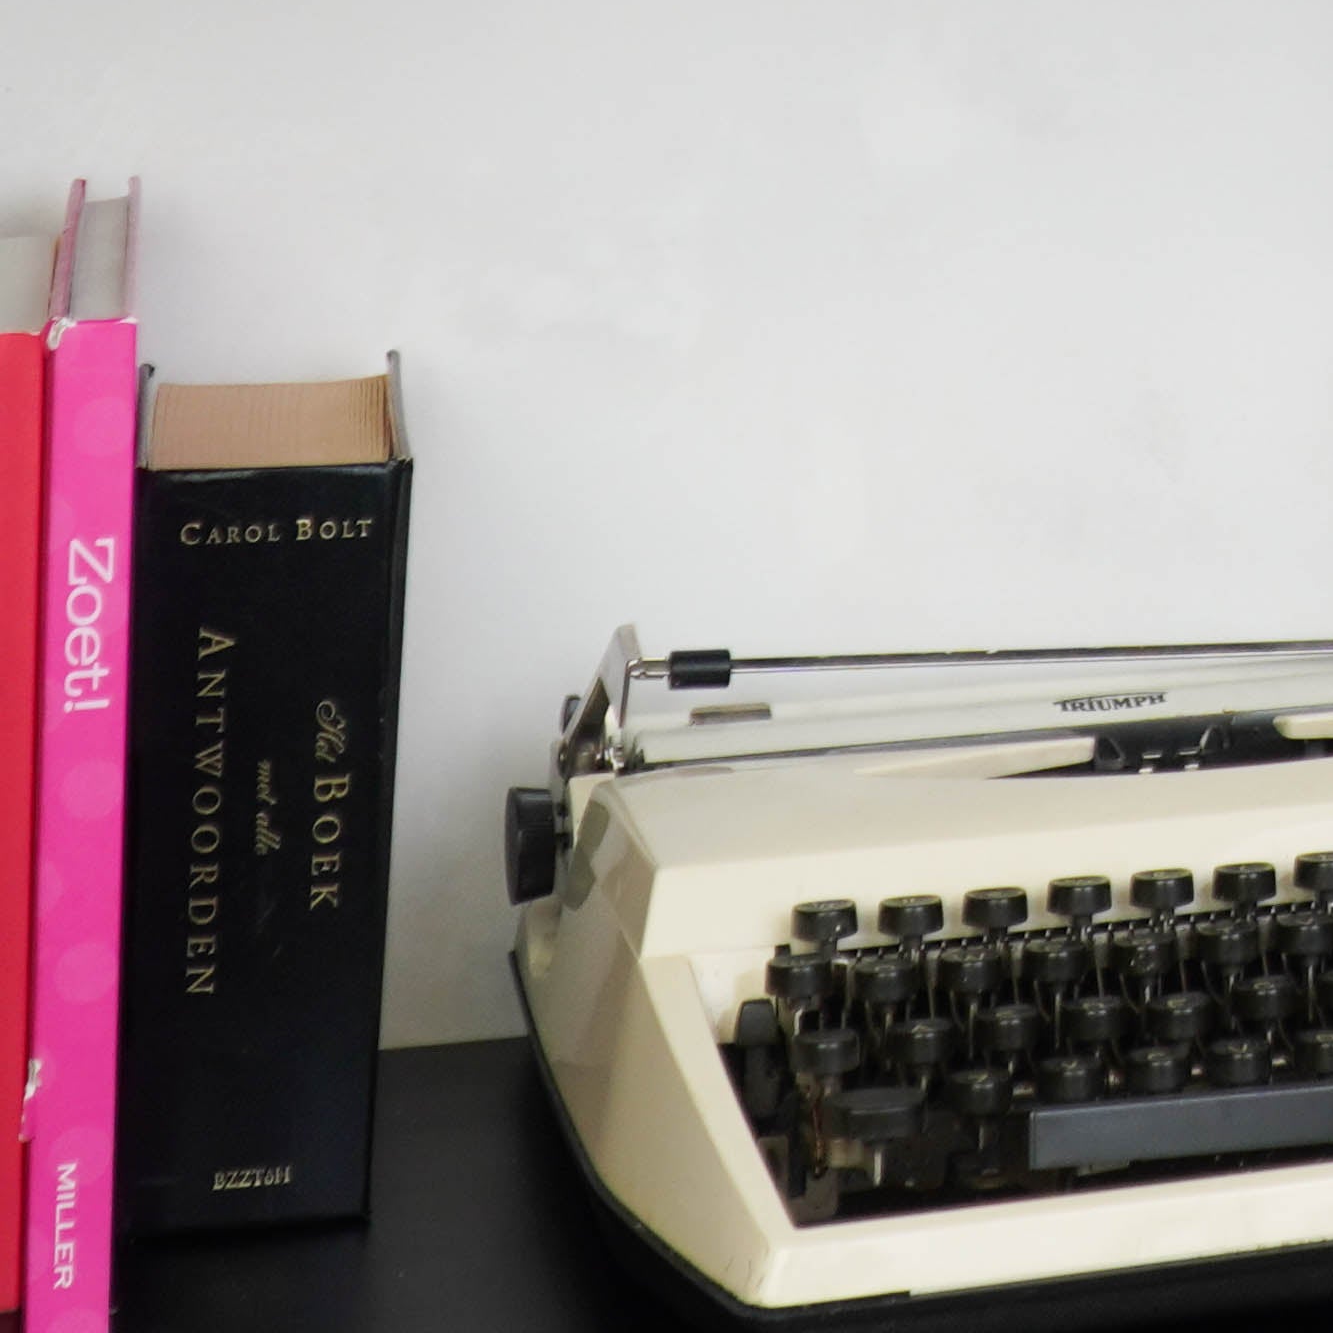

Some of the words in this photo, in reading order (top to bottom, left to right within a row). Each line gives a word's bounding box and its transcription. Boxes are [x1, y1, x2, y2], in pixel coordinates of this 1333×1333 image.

[180, 522, 281, 546] CAROL
[295, 518, 374, 540] BOLT
[63, 537, 115, 714] Zoet!
[315, 699, 347, 763] Het
[1052, 691, 1168, 712] TRIUMPH
[185, 627, 237, 995] ANTWOORDEN
[256, 758, 278, 805] met
[255, 812, 281, 856] alle
[309, 773, 351, 911] BOEK
[52, 1161, 78, 1291] MILLER
